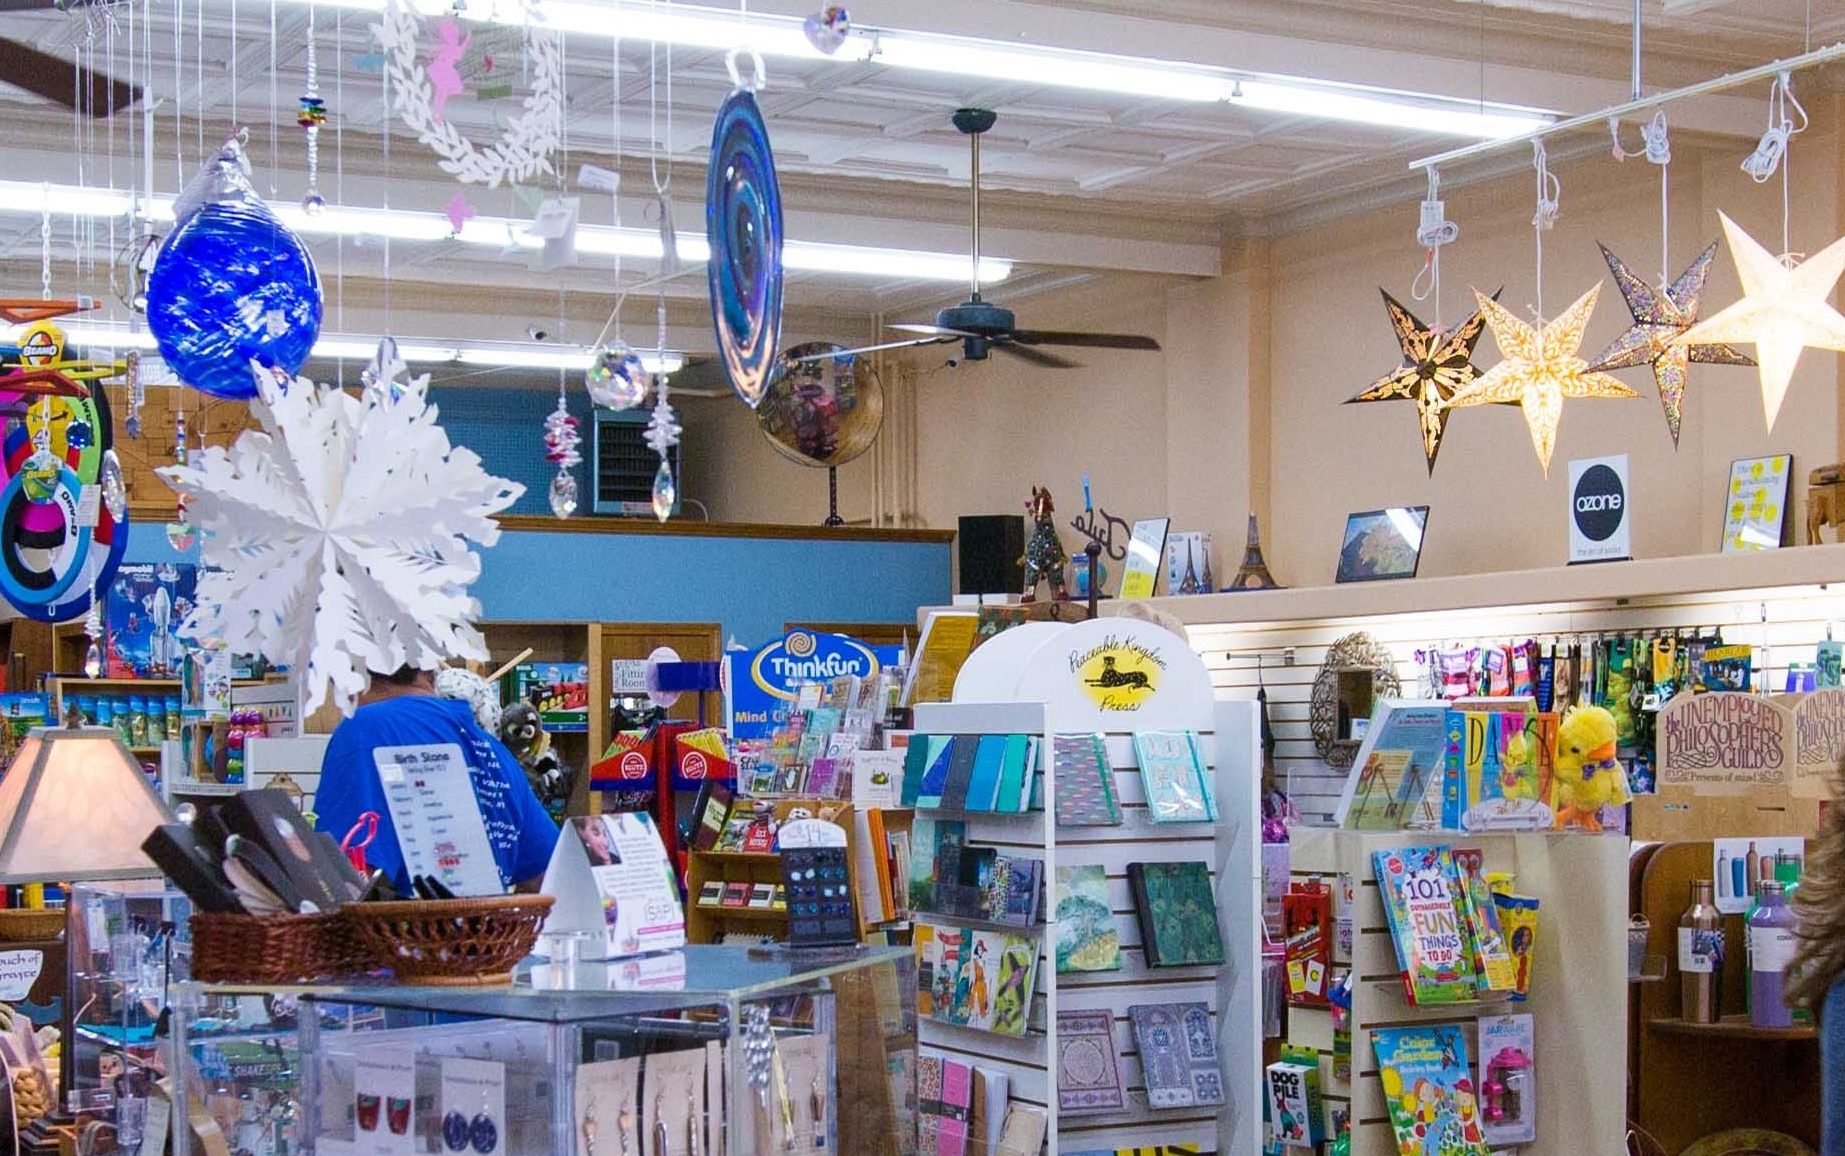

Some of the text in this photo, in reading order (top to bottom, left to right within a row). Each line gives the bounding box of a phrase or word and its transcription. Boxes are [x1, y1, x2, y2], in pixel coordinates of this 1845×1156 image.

[1576, 493, 1622, 513] ozone
[1068, 634, 1169, 673] Peaceable Kingdom
[1098, 694, 1141, 713] Press
[1405, 878, 1446, 901] 101
[1414, 912, 1455, 936] FUN
[1419, 934, 1460, 950] THINGS
[1427, 949, 1453, 962] TO DO
[1271, 1070, 1299, 1087] DOG
[1272, 1084, 1300, 1100] PILE
